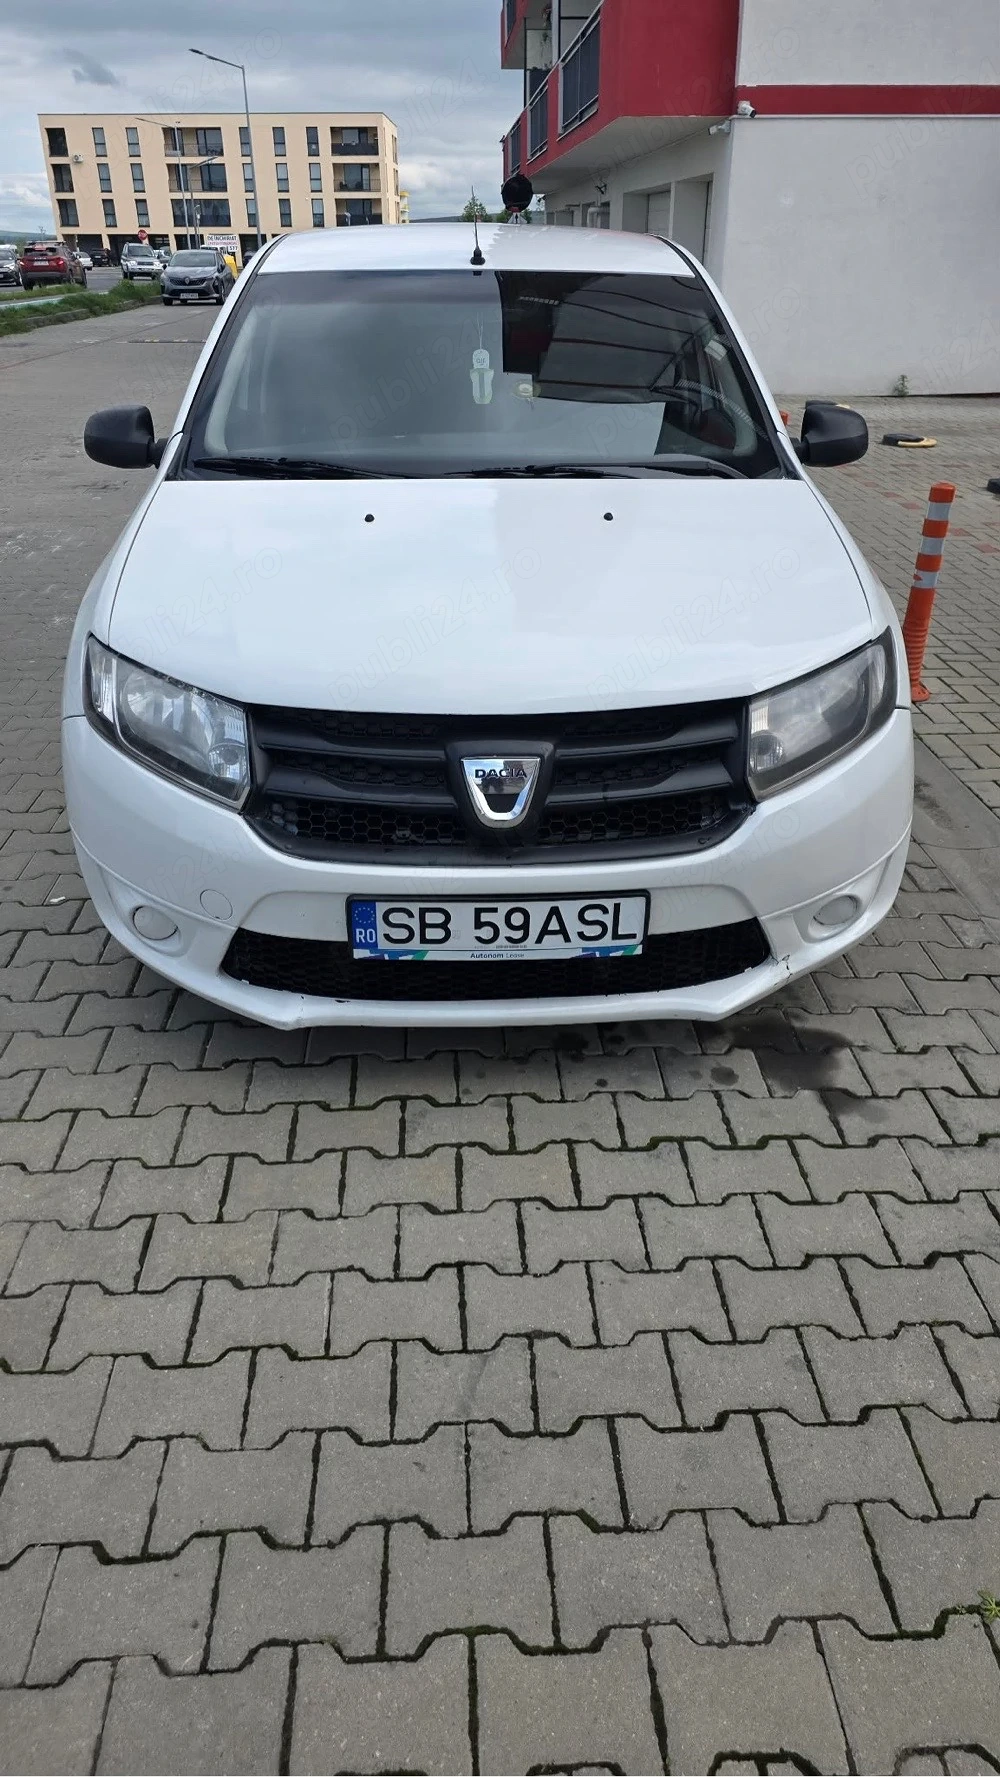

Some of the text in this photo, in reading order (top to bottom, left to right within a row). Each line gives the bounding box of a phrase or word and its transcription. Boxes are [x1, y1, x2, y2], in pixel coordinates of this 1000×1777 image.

[474, 768, 528, 779] DACIA
[355, 902, 638, 946] RO SB 59ASL
